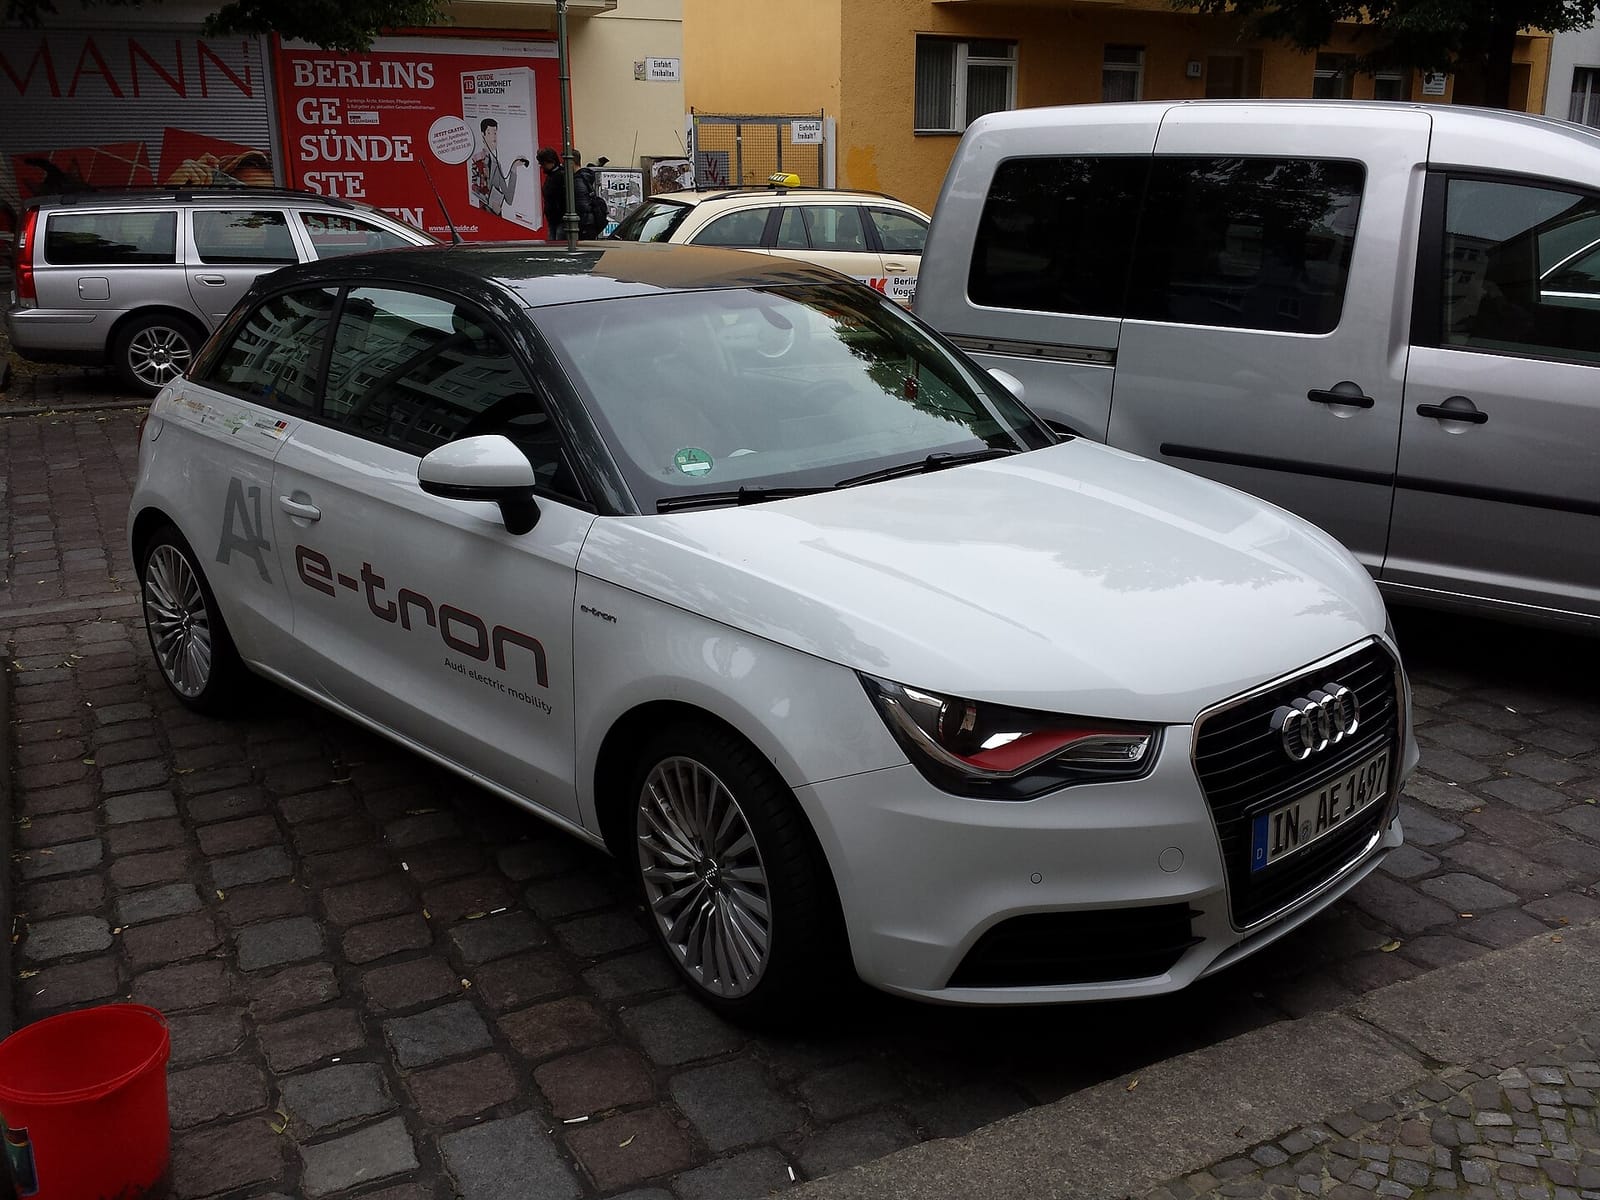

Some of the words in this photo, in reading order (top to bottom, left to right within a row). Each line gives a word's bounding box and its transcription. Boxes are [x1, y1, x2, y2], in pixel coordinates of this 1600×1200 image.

[292, 60, 435, 90] BERLINS
[653, 60, 672, 68] Einfahrt
[477, 80, 512, 88] GESUNDHEIT
[297, 98, 341, 125] GE
[301, 129, 414, 162] SÜNDE
[303, 171, 366, 198] STE
[216, 477, 272, 584] A1
[295, 544, 549, 689] e-tron
[580, 605, 617, 623] e-tron
[444, 658, 466, 674] Audi
[468, 670, 505, 692] electric
[507, 688, 552, 715] mobility
[1271, 803, 1300, 856] IN
[1315, 782, 1342, 834] AE
[1256, 848, 1263, 859] D
